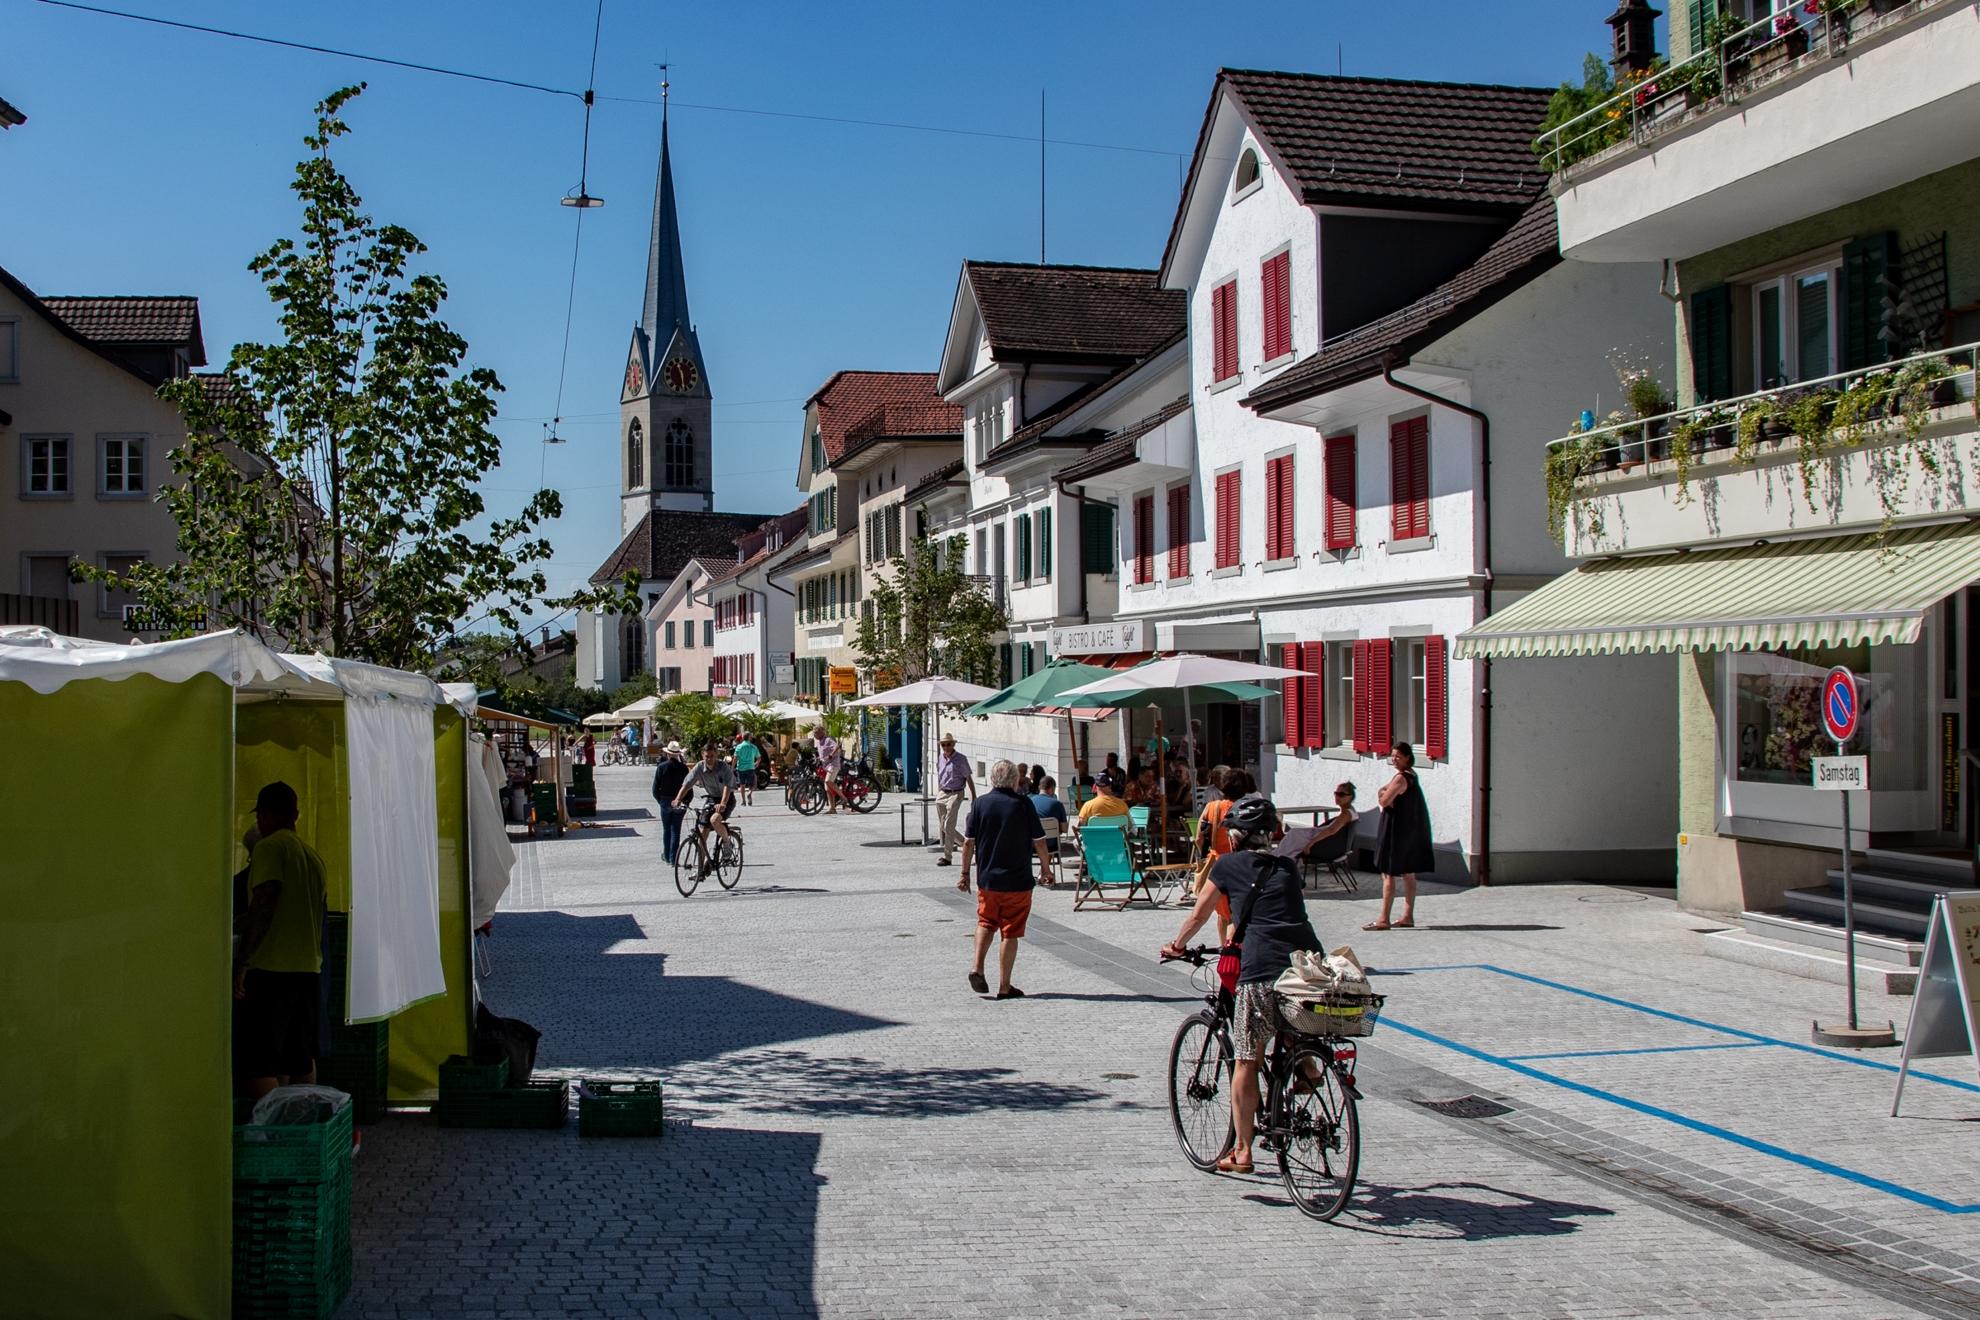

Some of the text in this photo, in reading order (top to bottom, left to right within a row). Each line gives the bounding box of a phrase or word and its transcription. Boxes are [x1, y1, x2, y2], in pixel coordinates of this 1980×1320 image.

[1069, 631, 1089, 648] BISTRO
[1091, 631, 1095, 647] &
[1097, 627, 1114, 647] CAFÉ
[1820, 763, 1860, 785] Samstag
